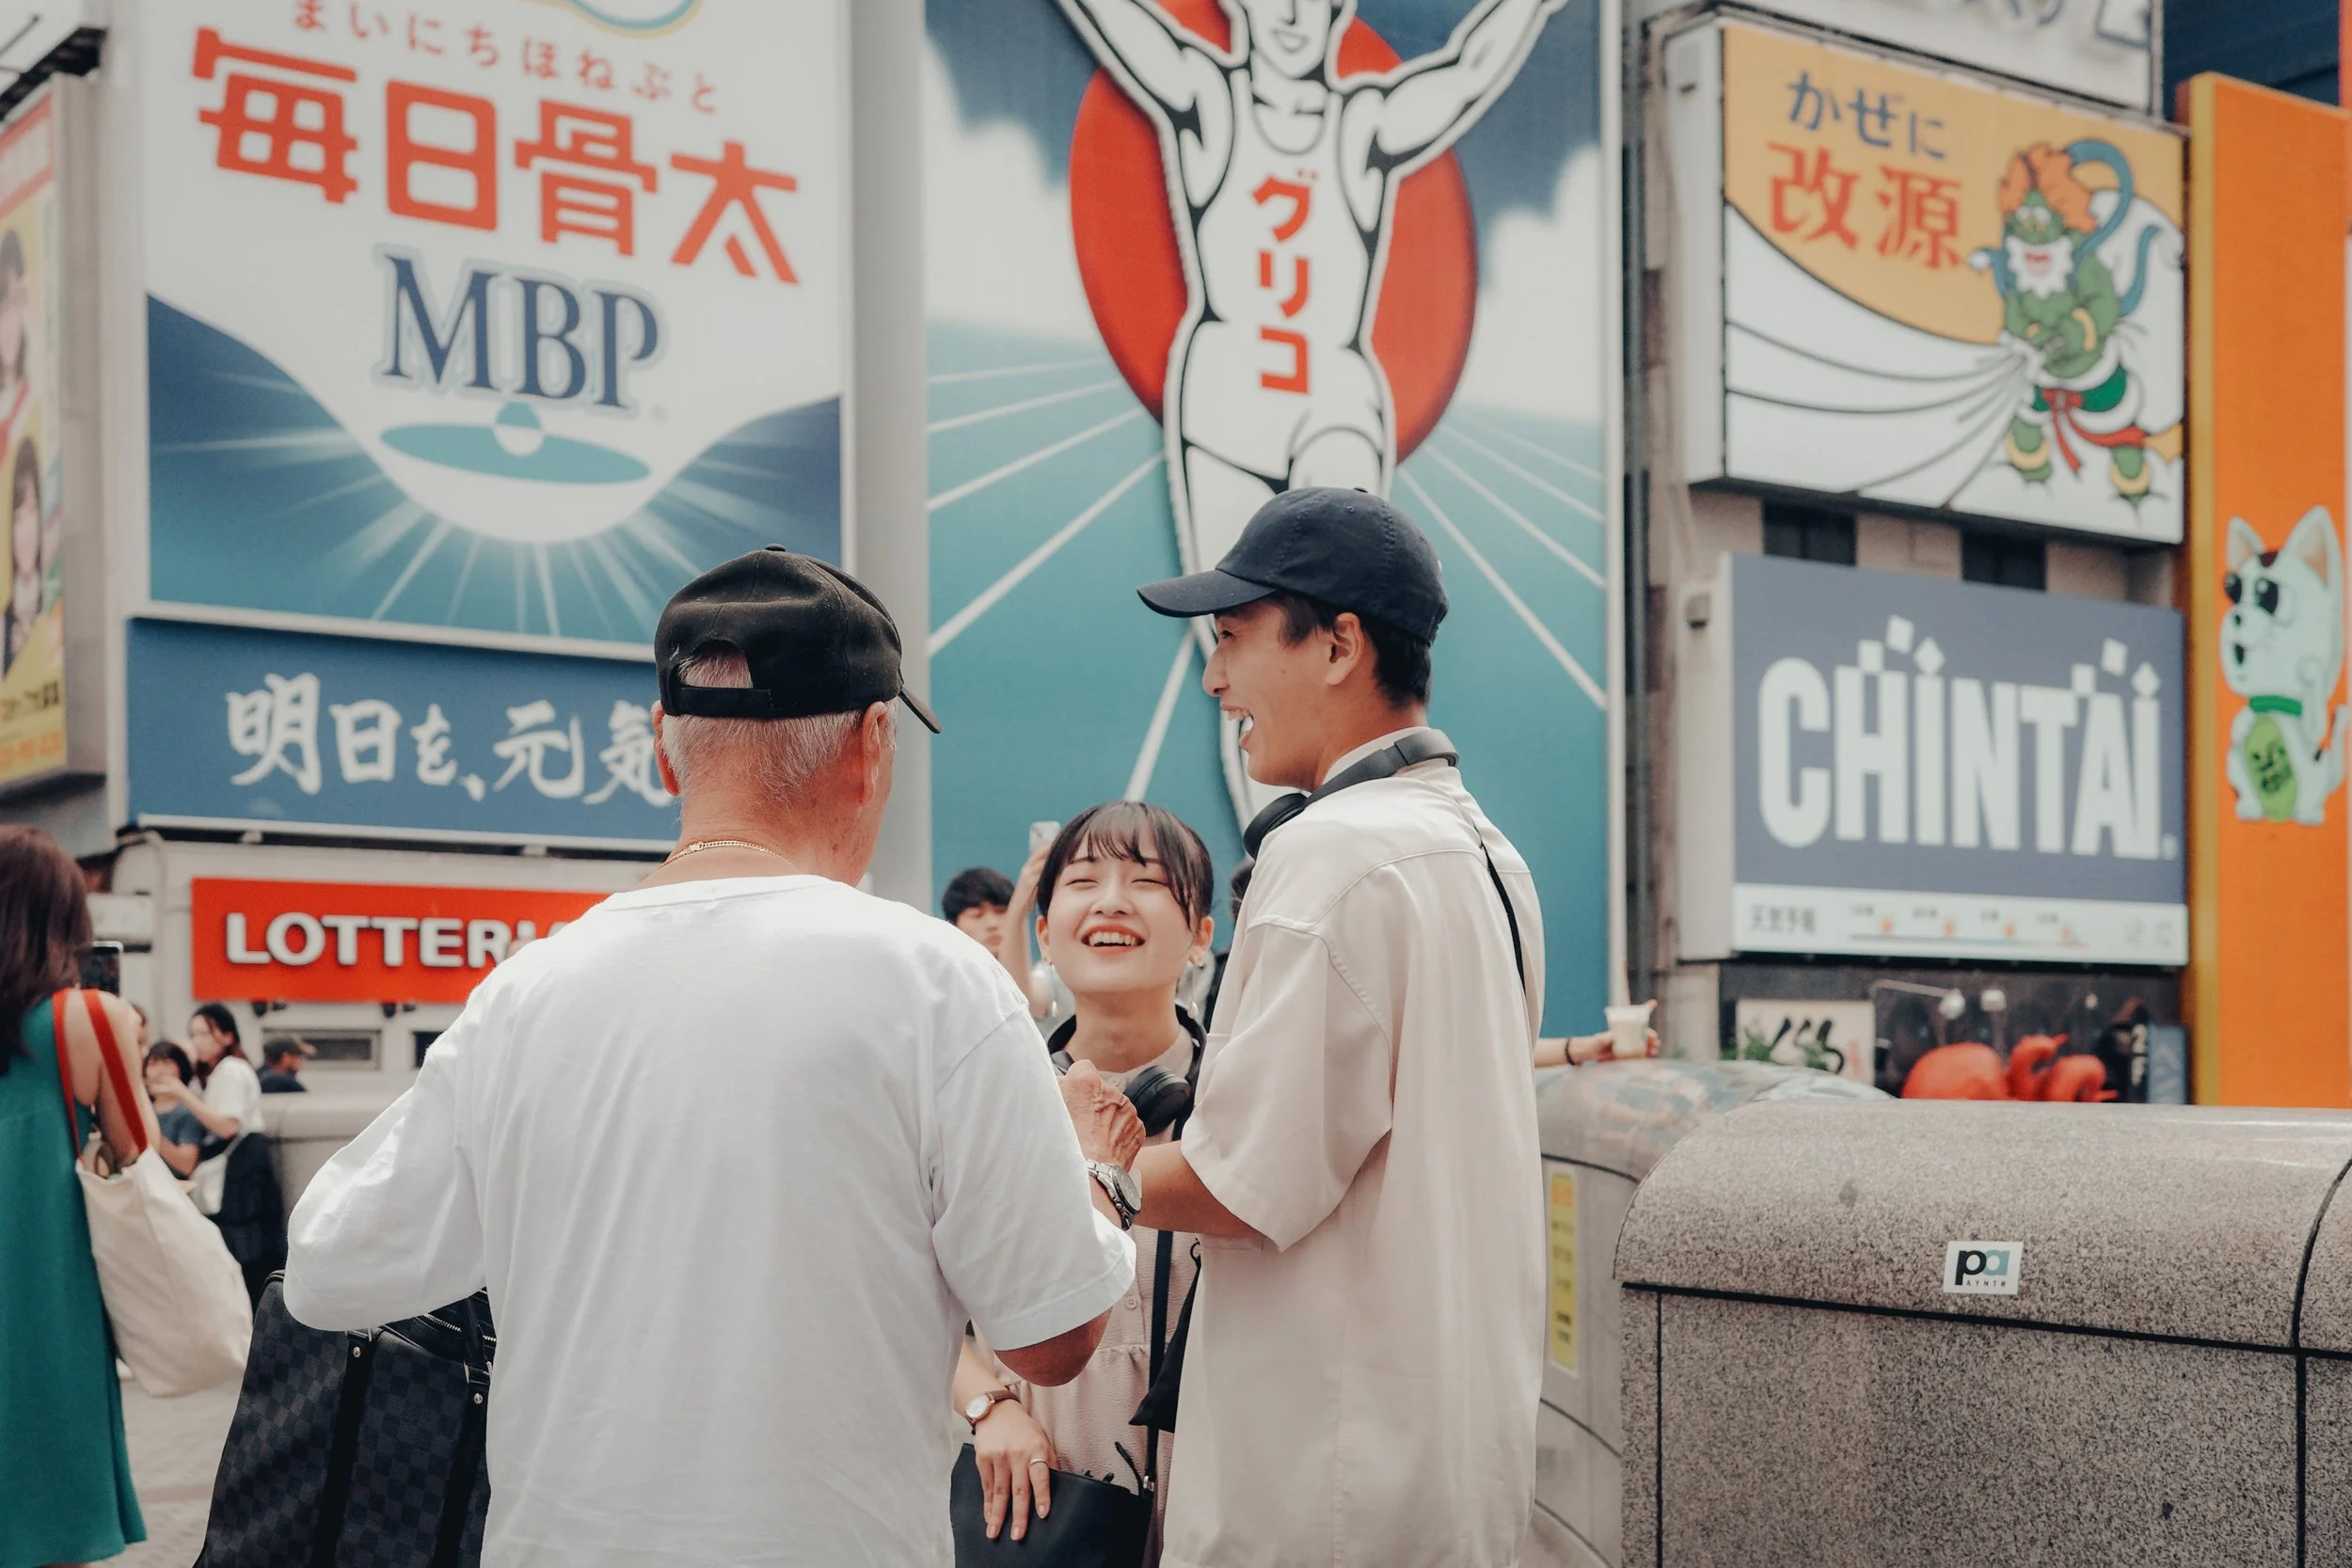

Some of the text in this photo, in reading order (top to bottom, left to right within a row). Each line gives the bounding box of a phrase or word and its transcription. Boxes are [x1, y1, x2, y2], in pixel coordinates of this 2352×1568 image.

[192, 26, 800, 285] 毎日骨太
[1767, 139, 1964, 270] 改源
[378, 251, 660, 410] MBP
[1250, 168, 1318, 393] グリコ
[1954, 1249, 2010, 1286] pa
